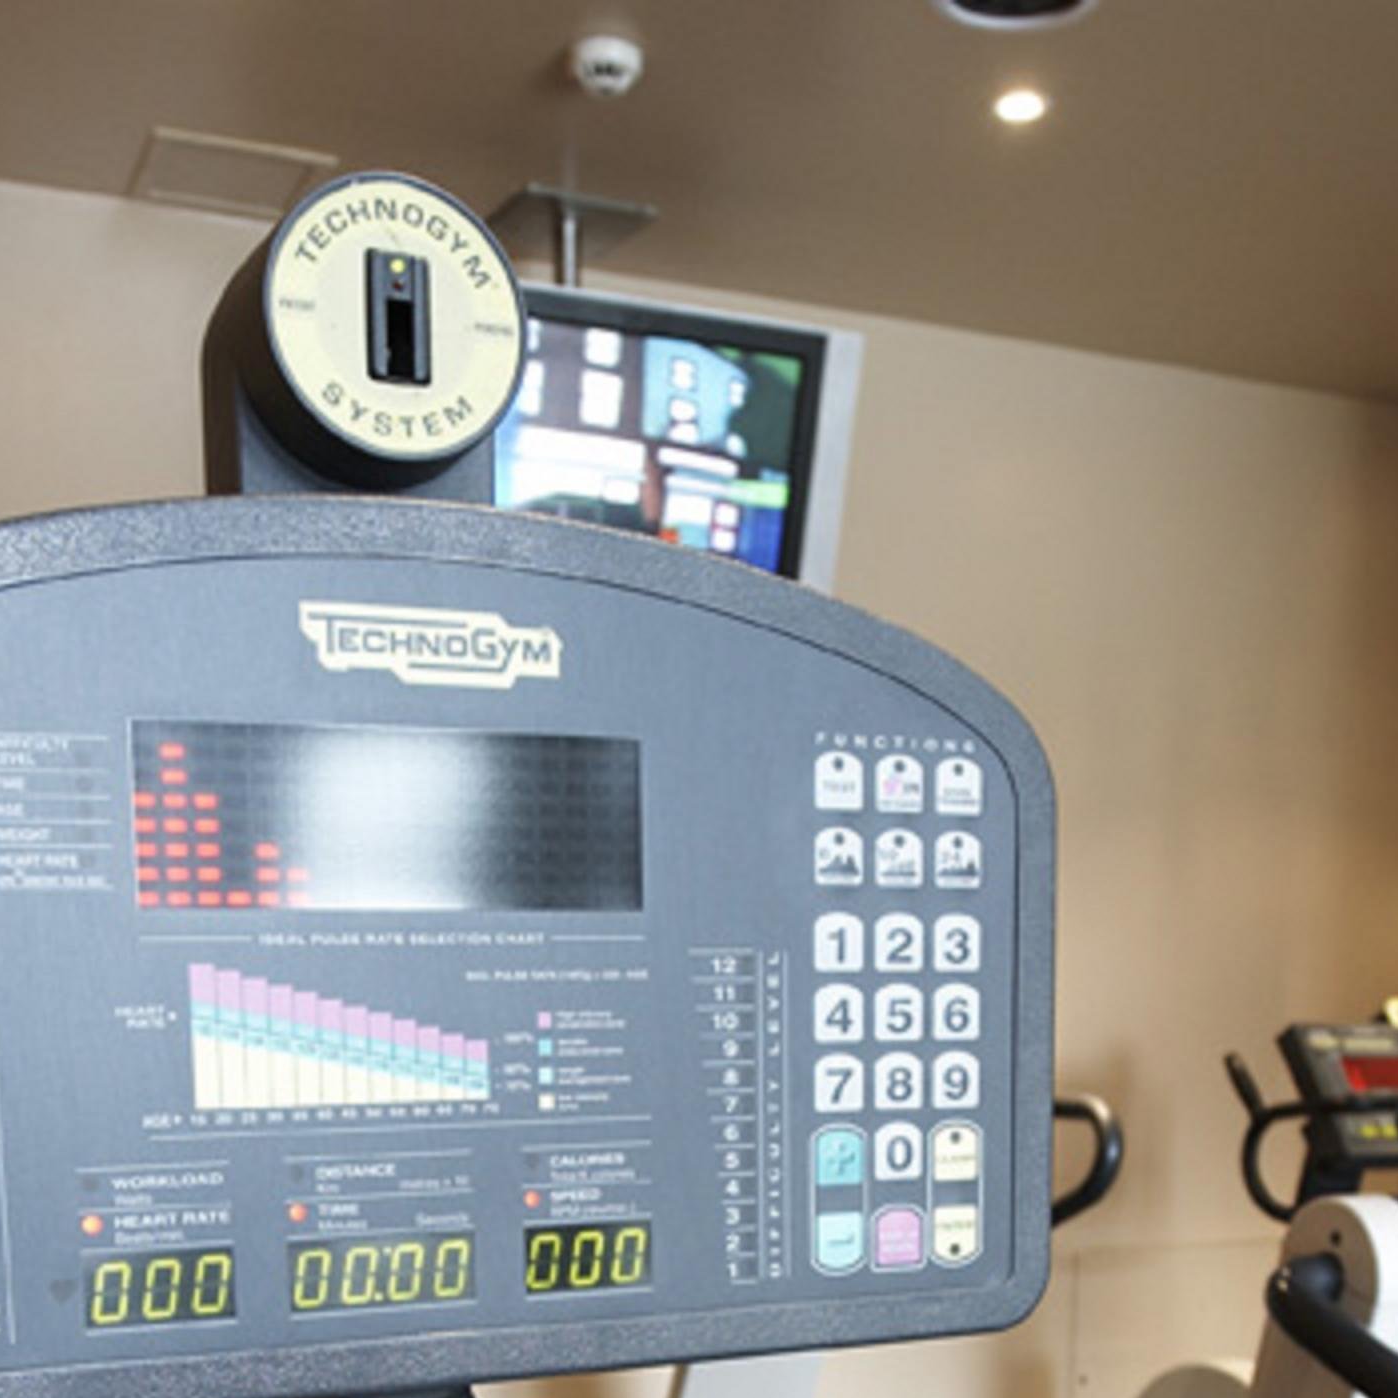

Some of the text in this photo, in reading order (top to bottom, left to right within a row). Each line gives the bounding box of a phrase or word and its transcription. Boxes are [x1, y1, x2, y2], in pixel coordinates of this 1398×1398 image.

[295, 198, 492, 290] TECHNOGYM
[322, 381, 472, 438] SYSTEM
[815, 731, 976, 754] FUNCTIONS
[259, 932, 545, 946] IDEAL PULSE RATE SELECTION CHART
[826, 927, 970, 965] 1 2 3
[711, 957, 737, 974] 12
[713, 985, 736, 1002] 11
[712, 1013, 740, 1030] 10
[825, 997, 970, 1034] 4 5 6
[722, 1040, 739, 1058] 9
[722, 1067, 740, 1085] 8
[825, 1065, 970, 1104] 7 8 9
[724, 1095, 740, 1113] 7
[723, 1123, 740, 1141] 6
[550, 1152, 626, 1169] CALORIES
[724, 1151, 740, 1169] 5
[887, 1136, 914, 1172] 0
[111, 1171, 225, 1190] WORKLOAD
[315, 1163, 397, 1180] DISTANCE
[551, 1187, 602, 1203] SPEED
[724, 1179, 741, 1196] 4
[114, 1209, 231, 1229] HEART RATE
[318, 1203, 360, 1217] TIME
[725, 1207, 741, 1226] 3
[725, 1234, 741, 1252] 2
[526, 1227, 647, 1290] 000
[727, 1262, 739, 1278] 1
[92, 1254, 232, 1325] 000
